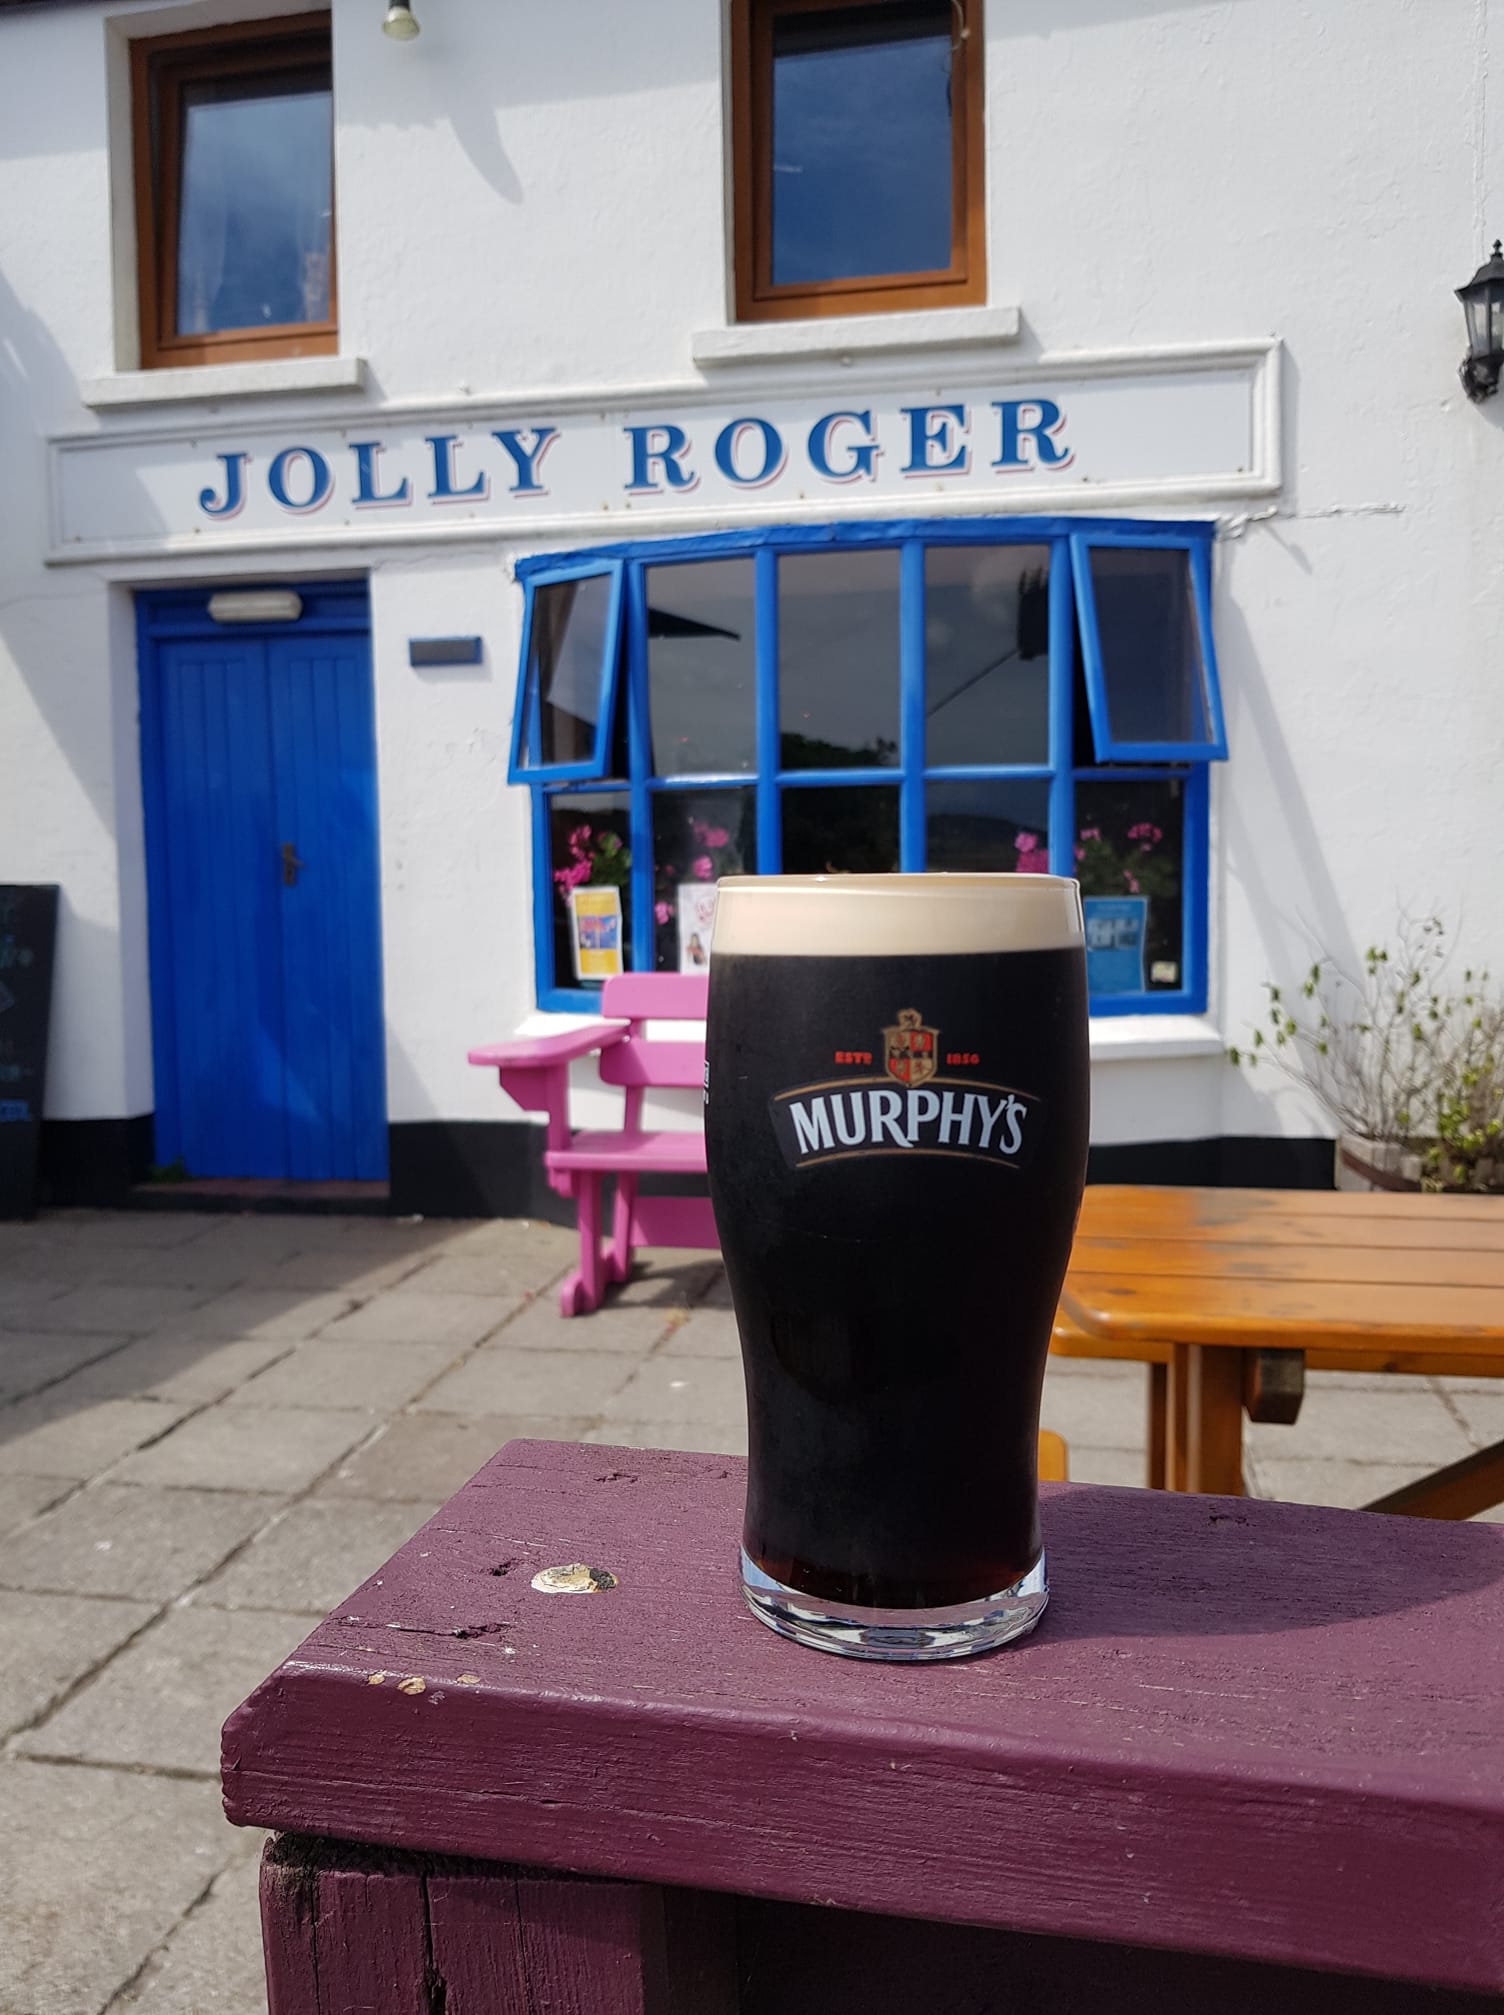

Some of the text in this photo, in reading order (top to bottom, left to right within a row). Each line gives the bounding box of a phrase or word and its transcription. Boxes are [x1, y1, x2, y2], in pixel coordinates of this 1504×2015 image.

[200, 399, 1075, 520] JOLLY ROGER
[789, 1089, 1027, 1155] MURPHY'S
